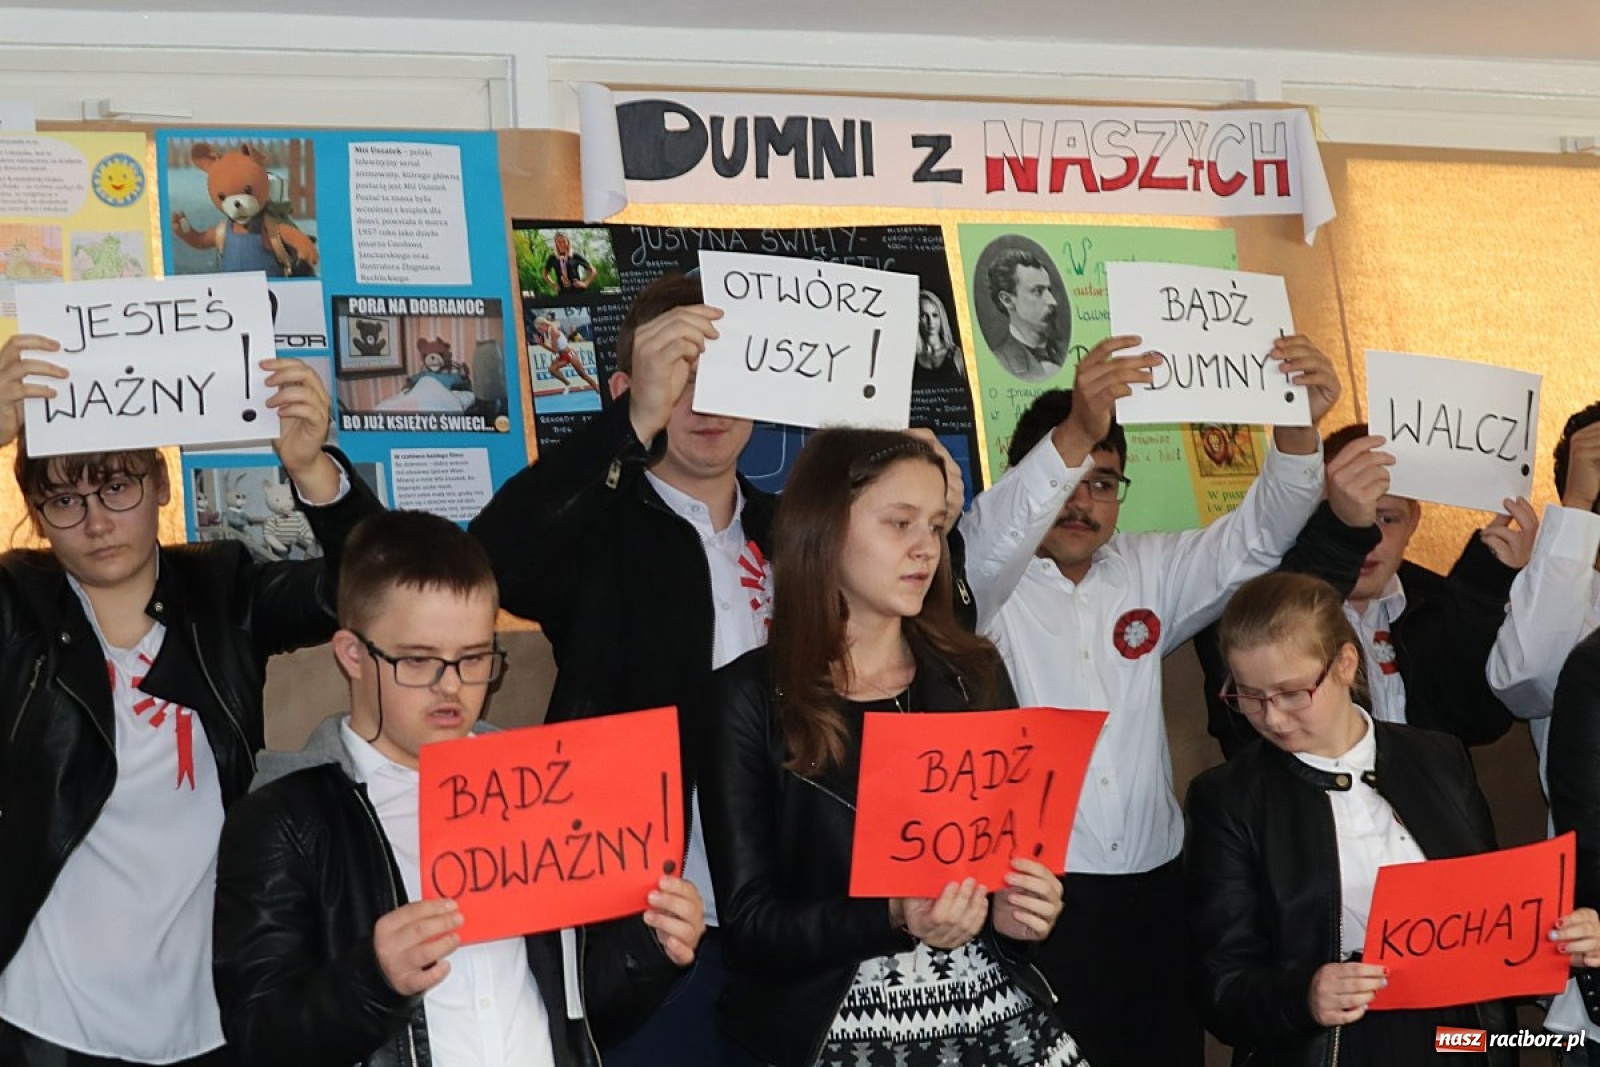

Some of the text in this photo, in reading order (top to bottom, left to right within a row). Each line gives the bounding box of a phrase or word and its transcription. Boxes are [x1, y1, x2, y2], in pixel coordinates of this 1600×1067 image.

[617, 98, 875, 182] DUMNI
[983, 117, 1291, 197] NASZYCH
[64, 287, 233, 353] JESTEŚ
[349, 297, 485, 316] PORA NA DOBRANOC
[723, 268, 887, 318] OTWÓRZ
[1159, 280, 1253, 331] BĄDŹ
[343, 414, 362, 430] BO
[363, 413, 385, 430] JUŻ
[1389, 388, 1534, 477] WALCZ!
[438, 739, 574, 821] BĄDŹ
[917, 726, 1034, 801] BĄDŹ
